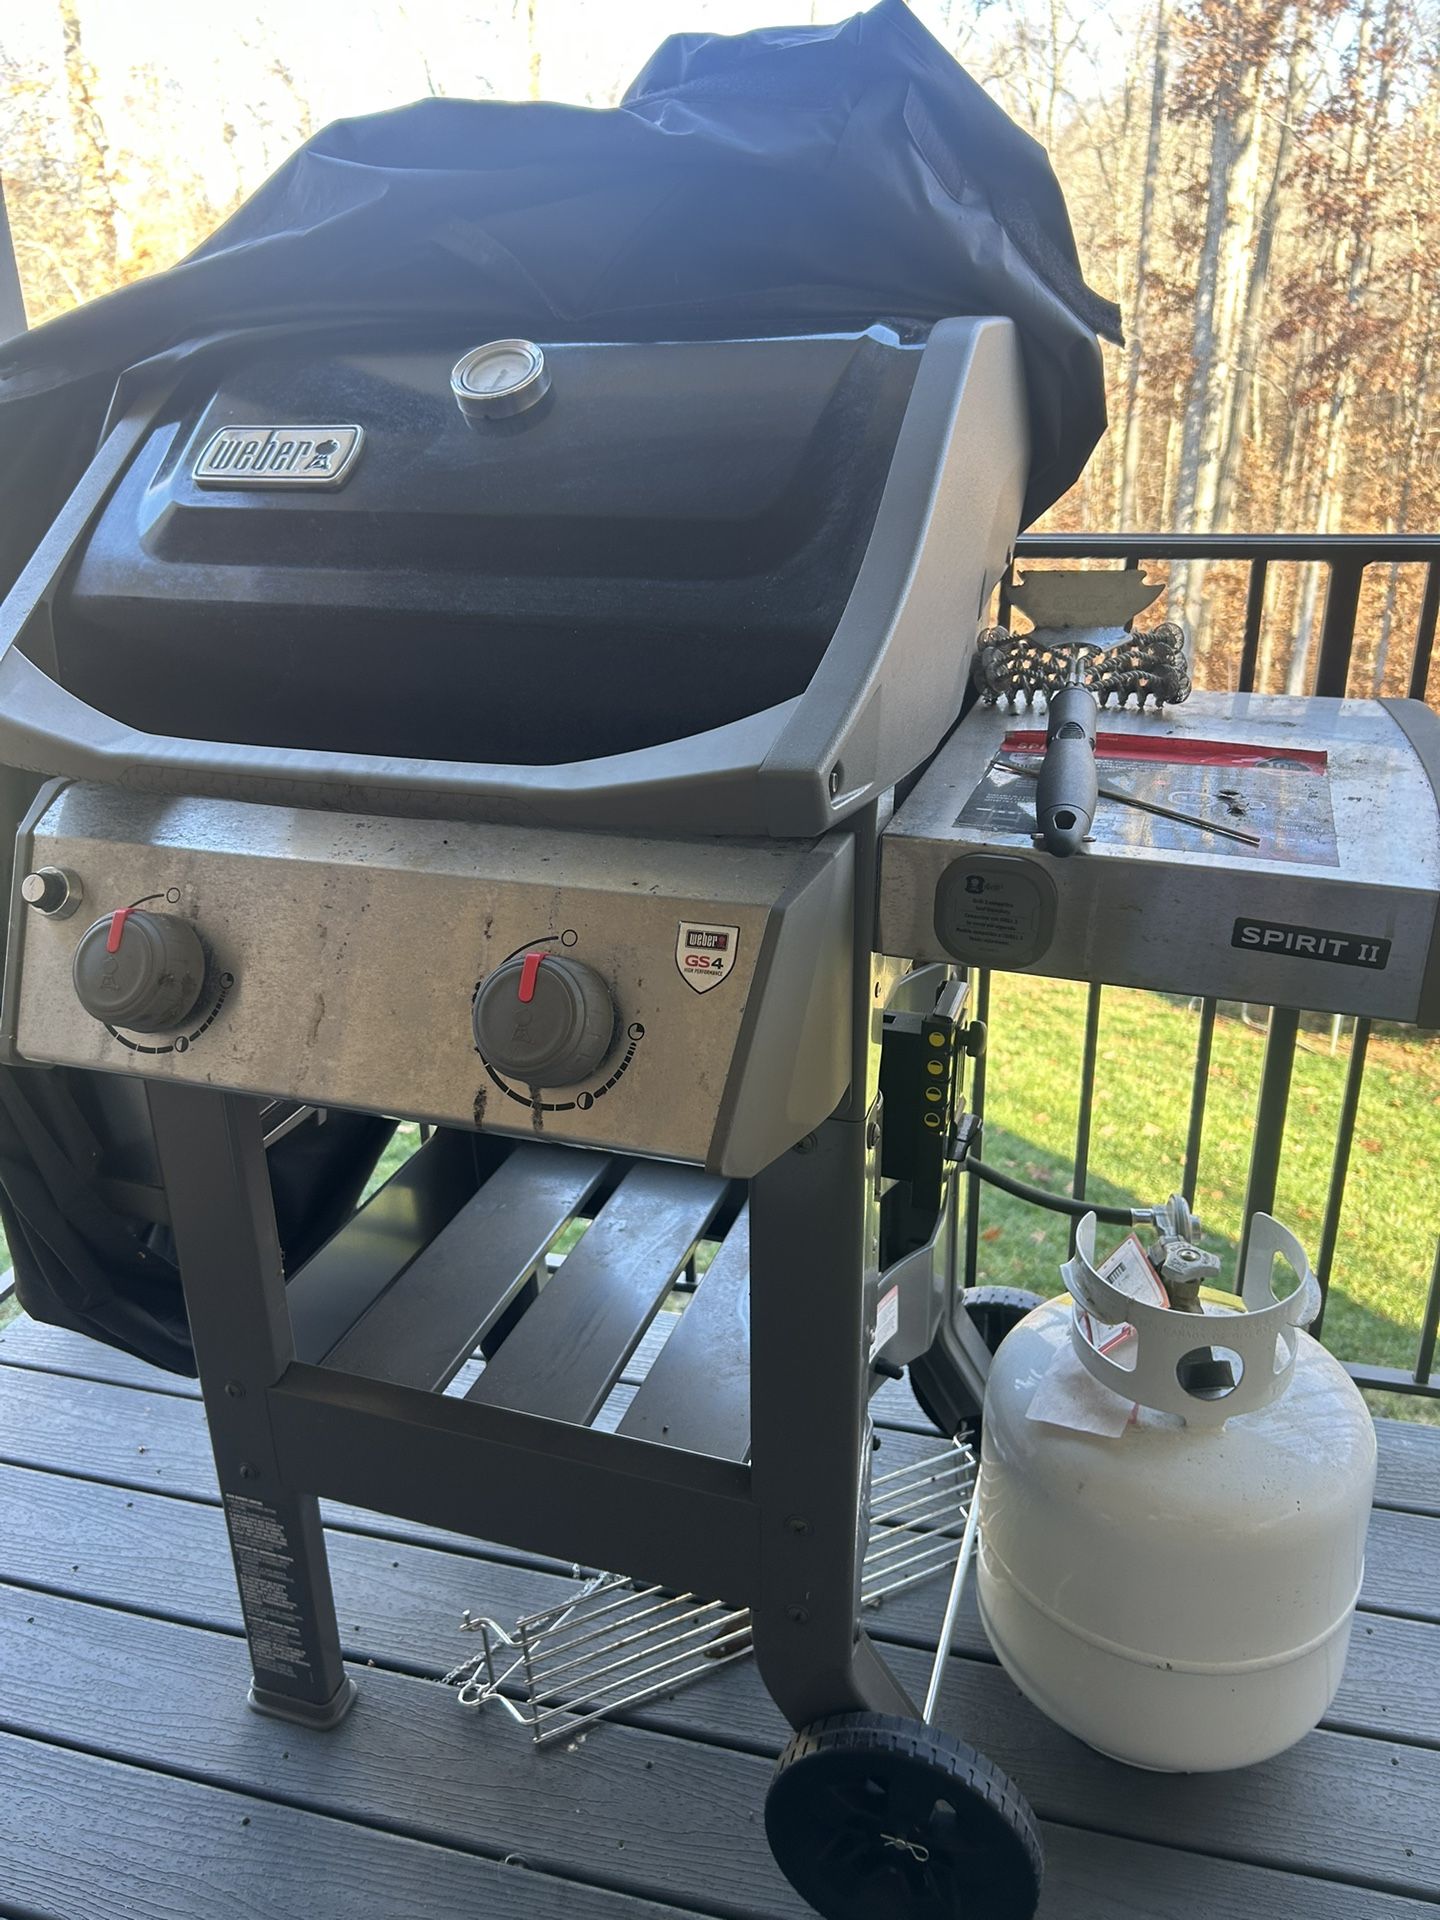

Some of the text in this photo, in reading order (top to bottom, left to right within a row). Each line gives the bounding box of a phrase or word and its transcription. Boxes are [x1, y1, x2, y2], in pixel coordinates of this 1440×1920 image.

[208, 430, 315, 472] weber
[689, 932, 718, 947] weber
[1241, 926, 1380, 962] SPIRIT II
[685, 954, 724, 969] GS4
